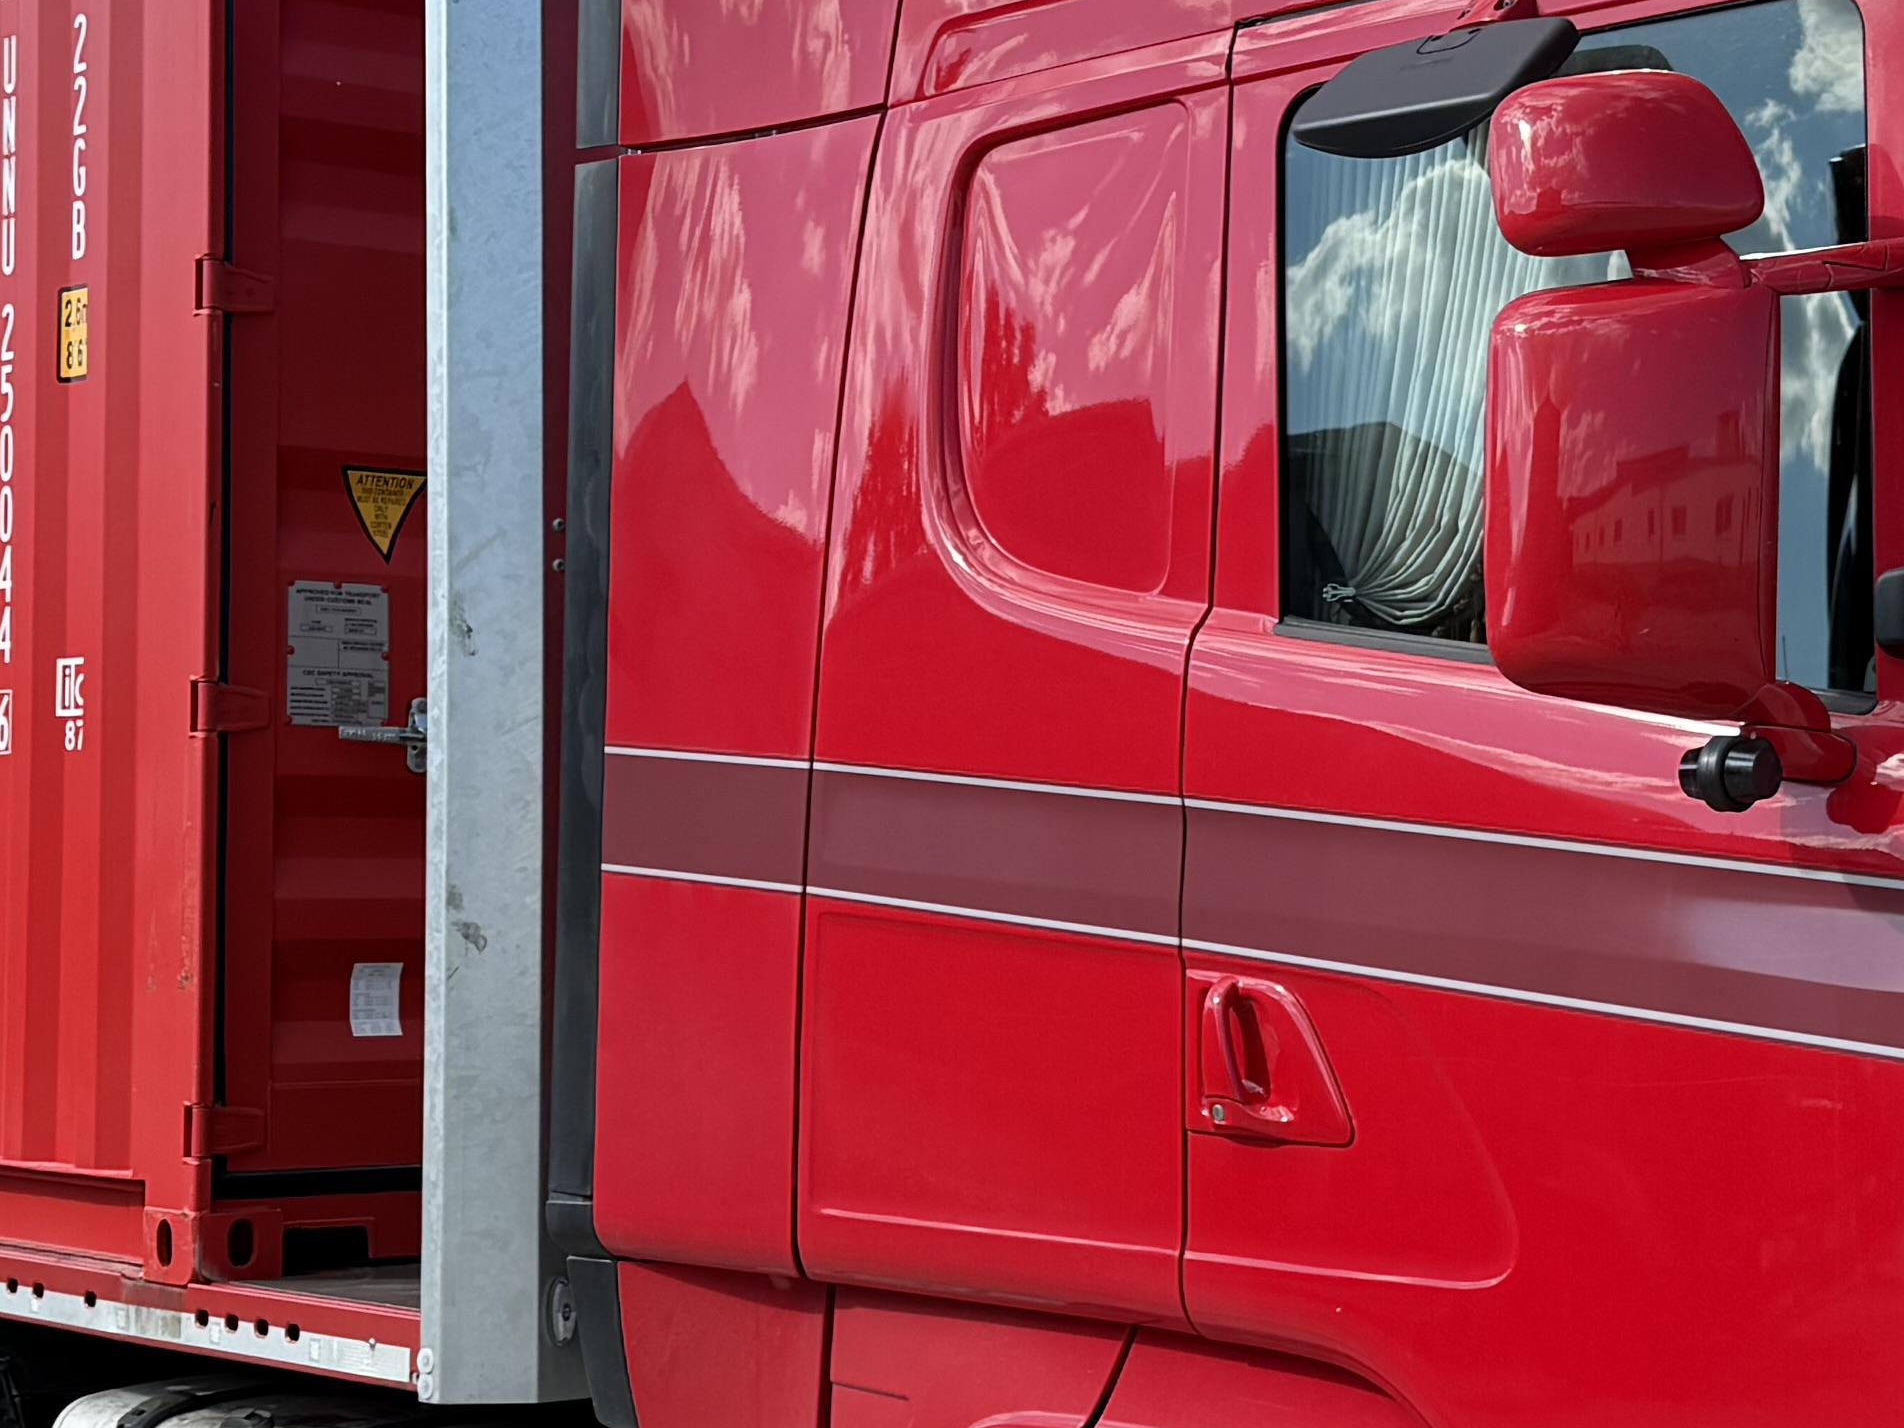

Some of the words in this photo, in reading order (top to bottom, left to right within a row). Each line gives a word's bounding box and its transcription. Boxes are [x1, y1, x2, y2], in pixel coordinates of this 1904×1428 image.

[0, 35, 17, 276] UNNU
[72, 13, 88, 260] 22GB
[356, 474, 415, 489] ATTENTION
